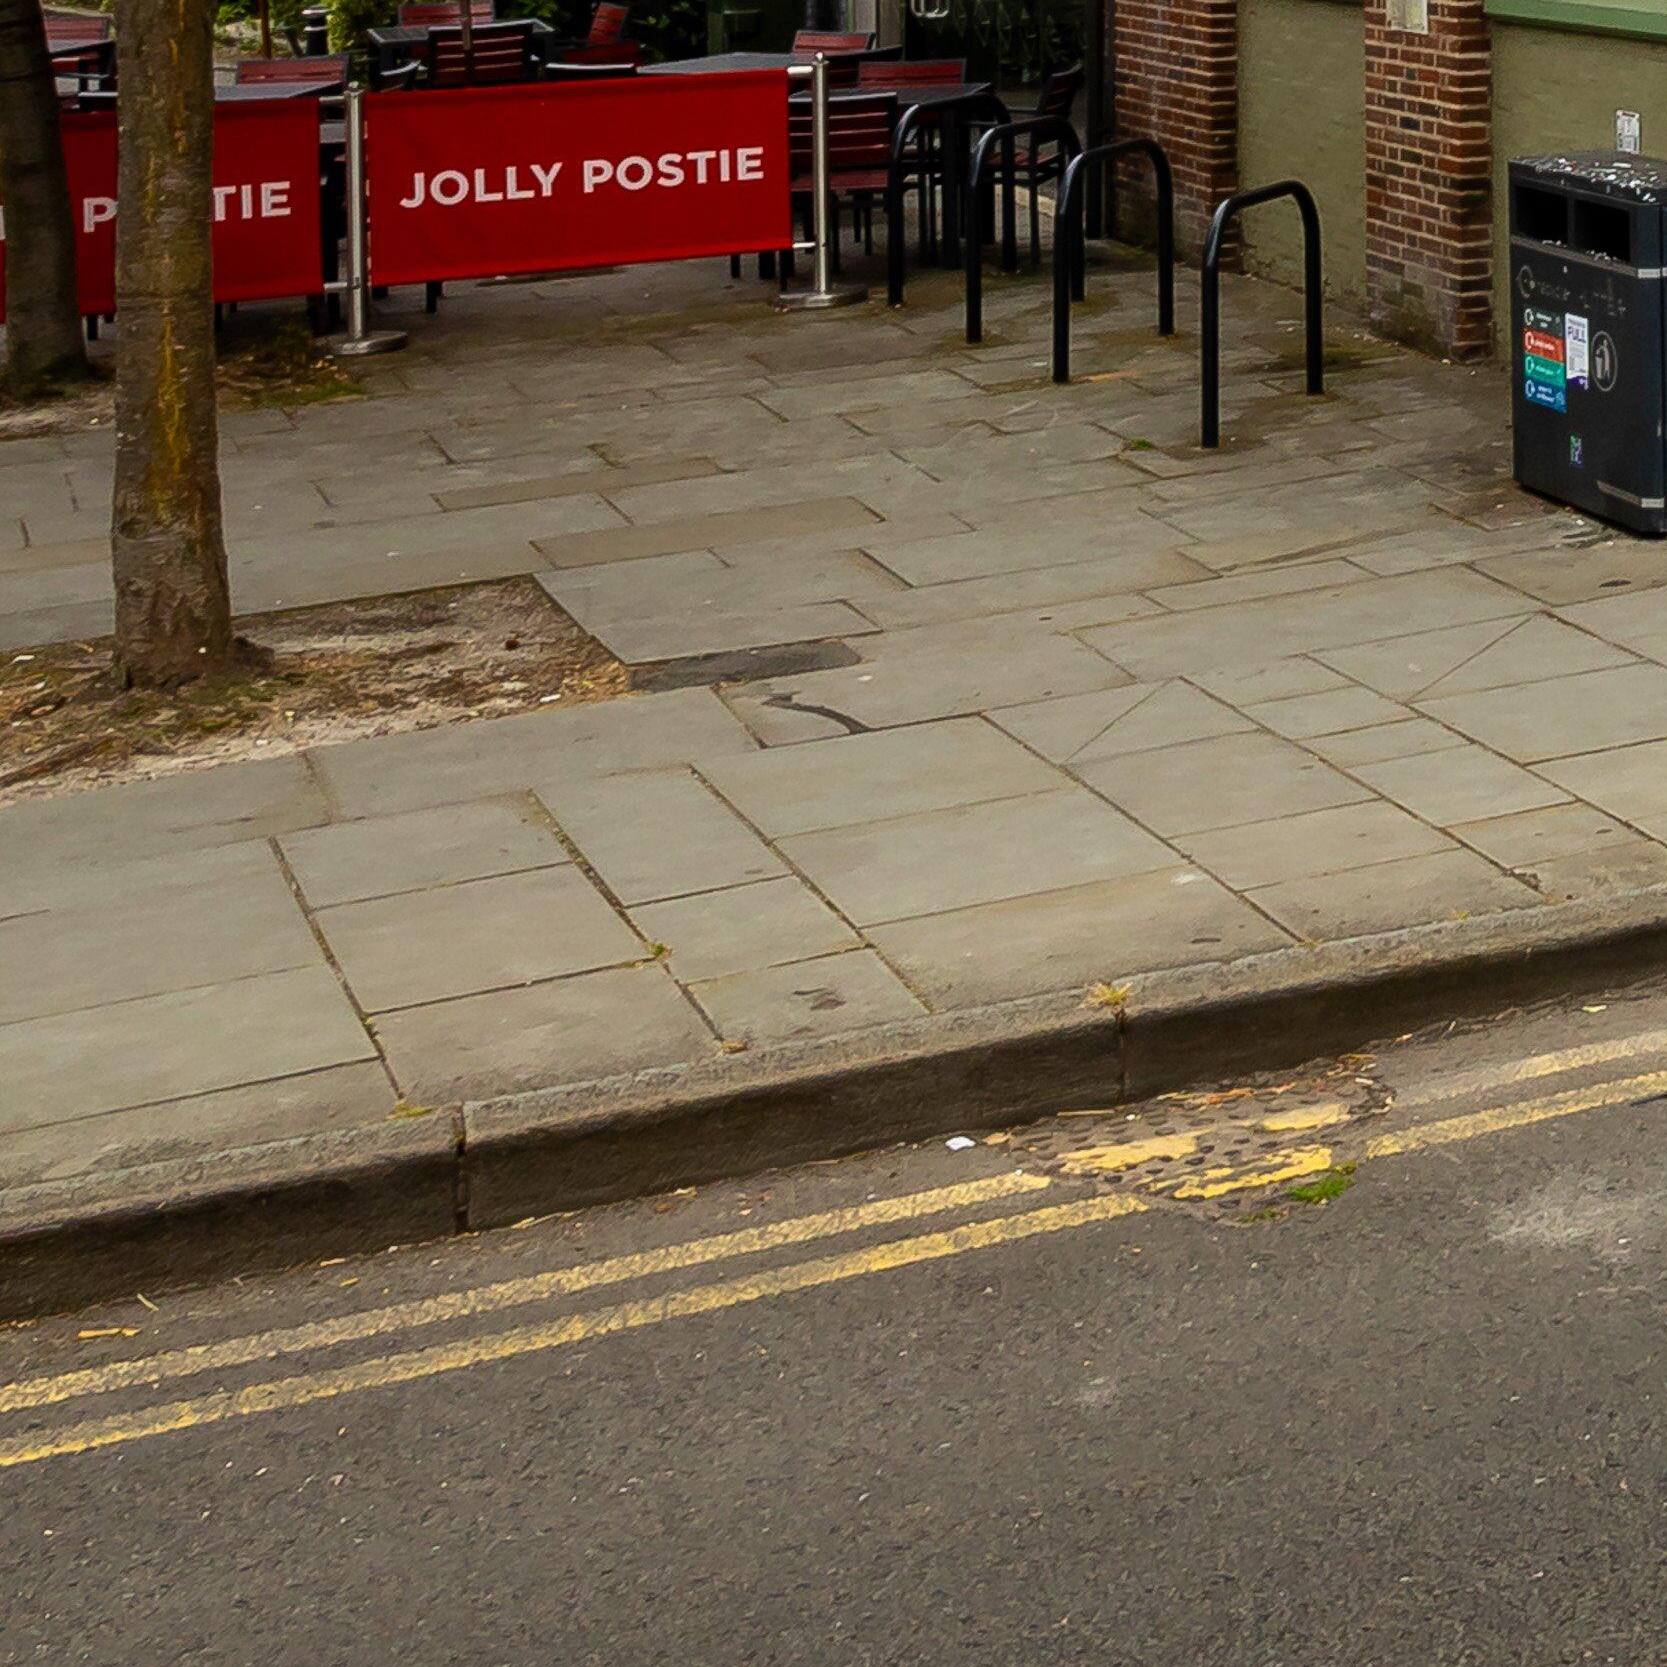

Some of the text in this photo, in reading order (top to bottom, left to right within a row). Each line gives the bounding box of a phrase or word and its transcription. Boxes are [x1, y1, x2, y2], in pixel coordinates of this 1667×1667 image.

[400, 146, 764, 208] JOLLY POSTIE
[83, 181, 291, 233] PTIE
